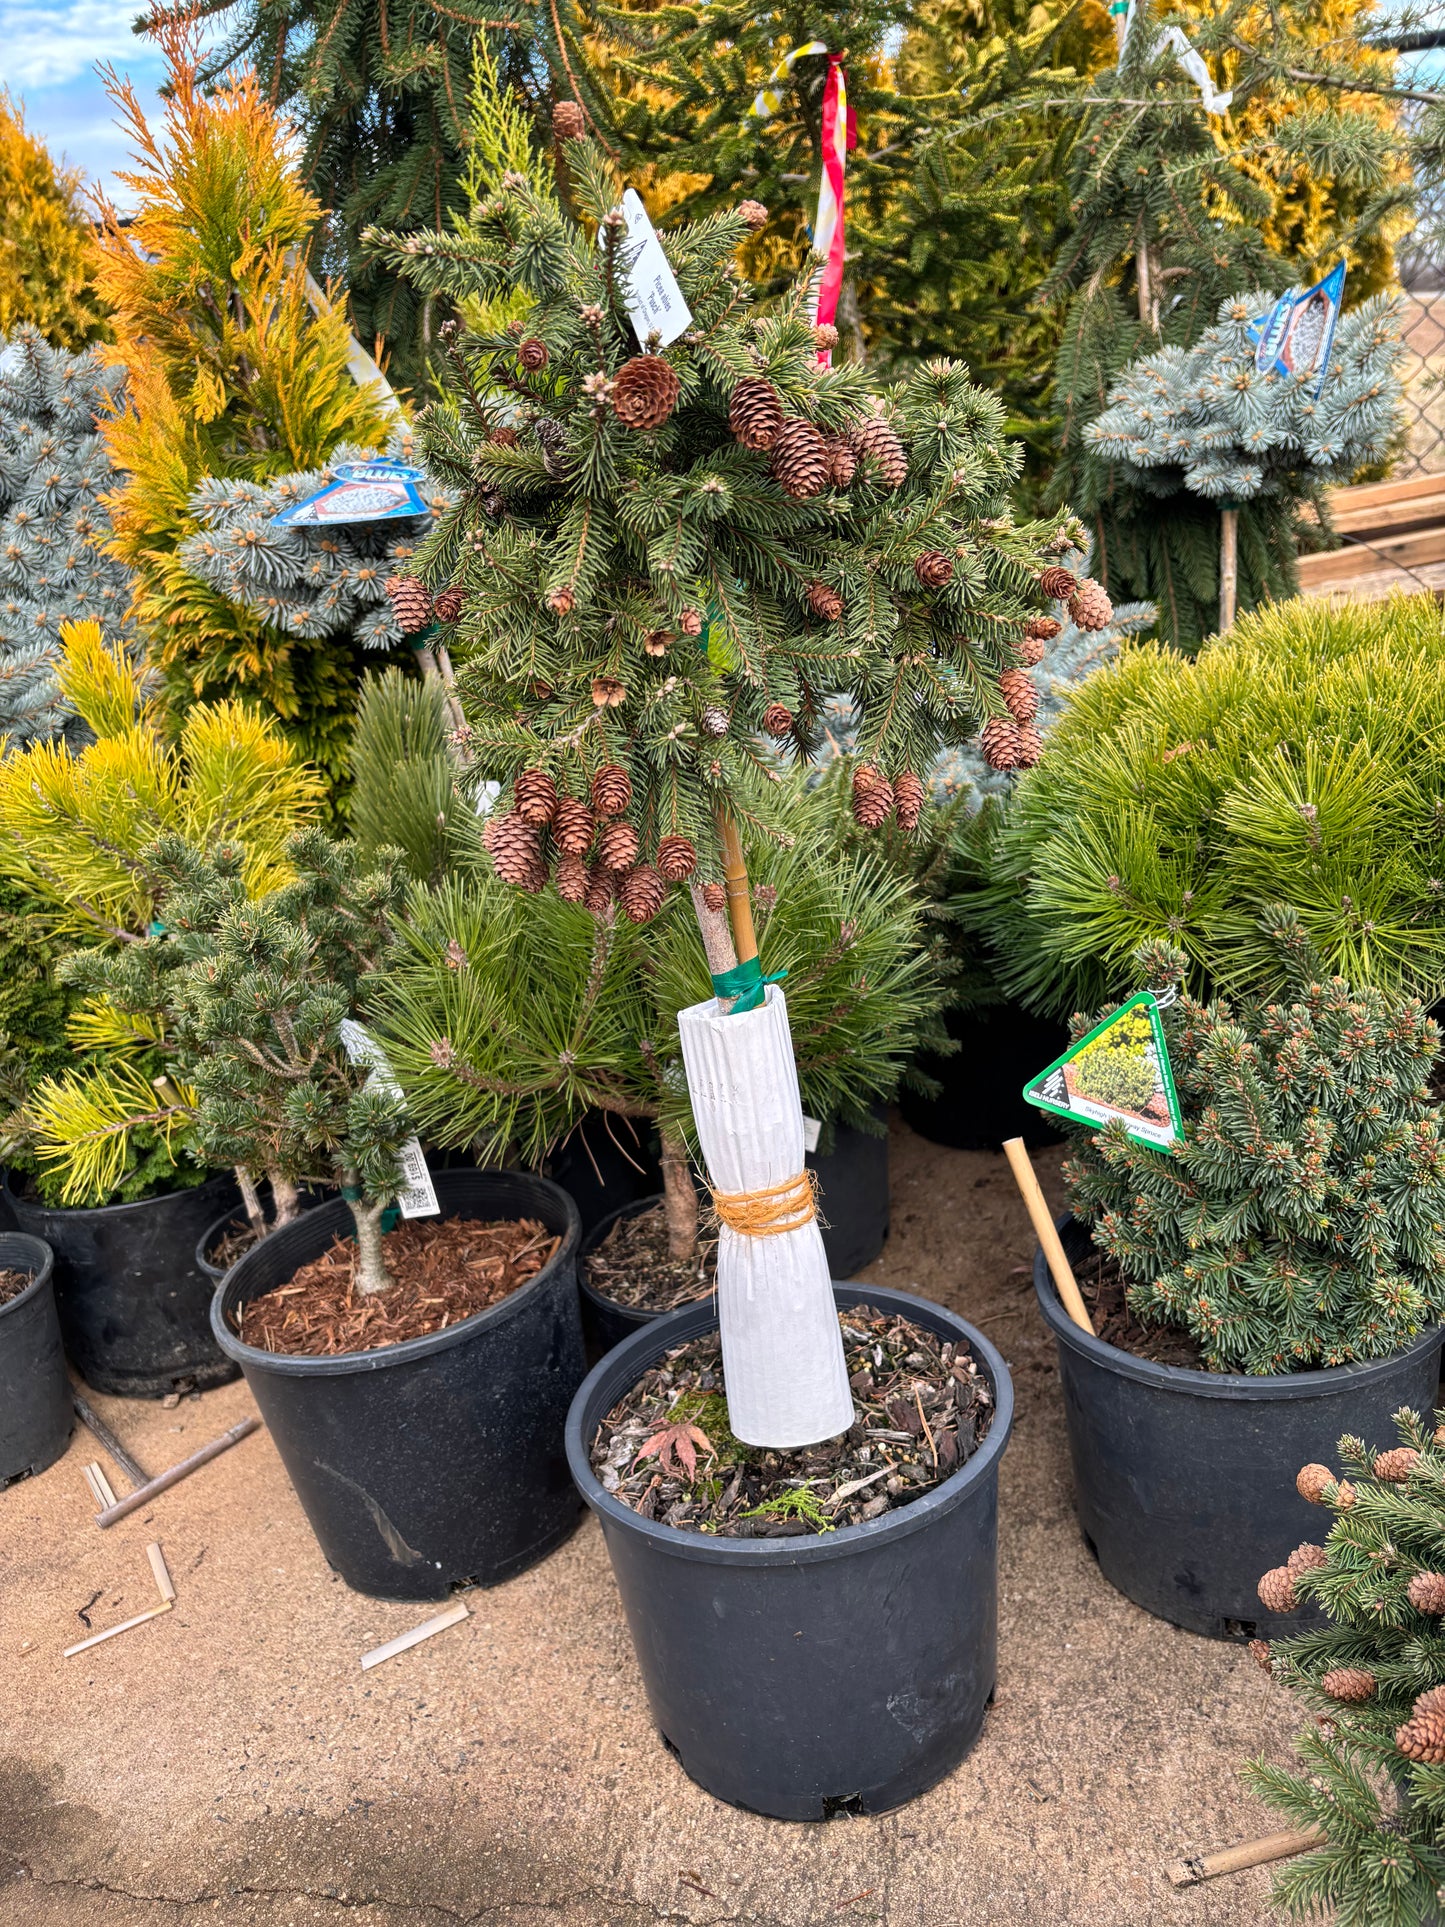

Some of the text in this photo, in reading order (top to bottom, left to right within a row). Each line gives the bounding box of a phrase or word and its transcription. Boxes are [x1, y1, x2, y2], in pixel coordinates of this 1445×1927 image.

[654, 274, 672, 312] Picea abies
[352, 469, 410, 480] BLUES
[1028, 1091, 1070, 1109] ISELI NURSERY
[1085, 1106, 1107, 1119] Skyhigh
[1141, 1127, 1162, 1138] Spruce
